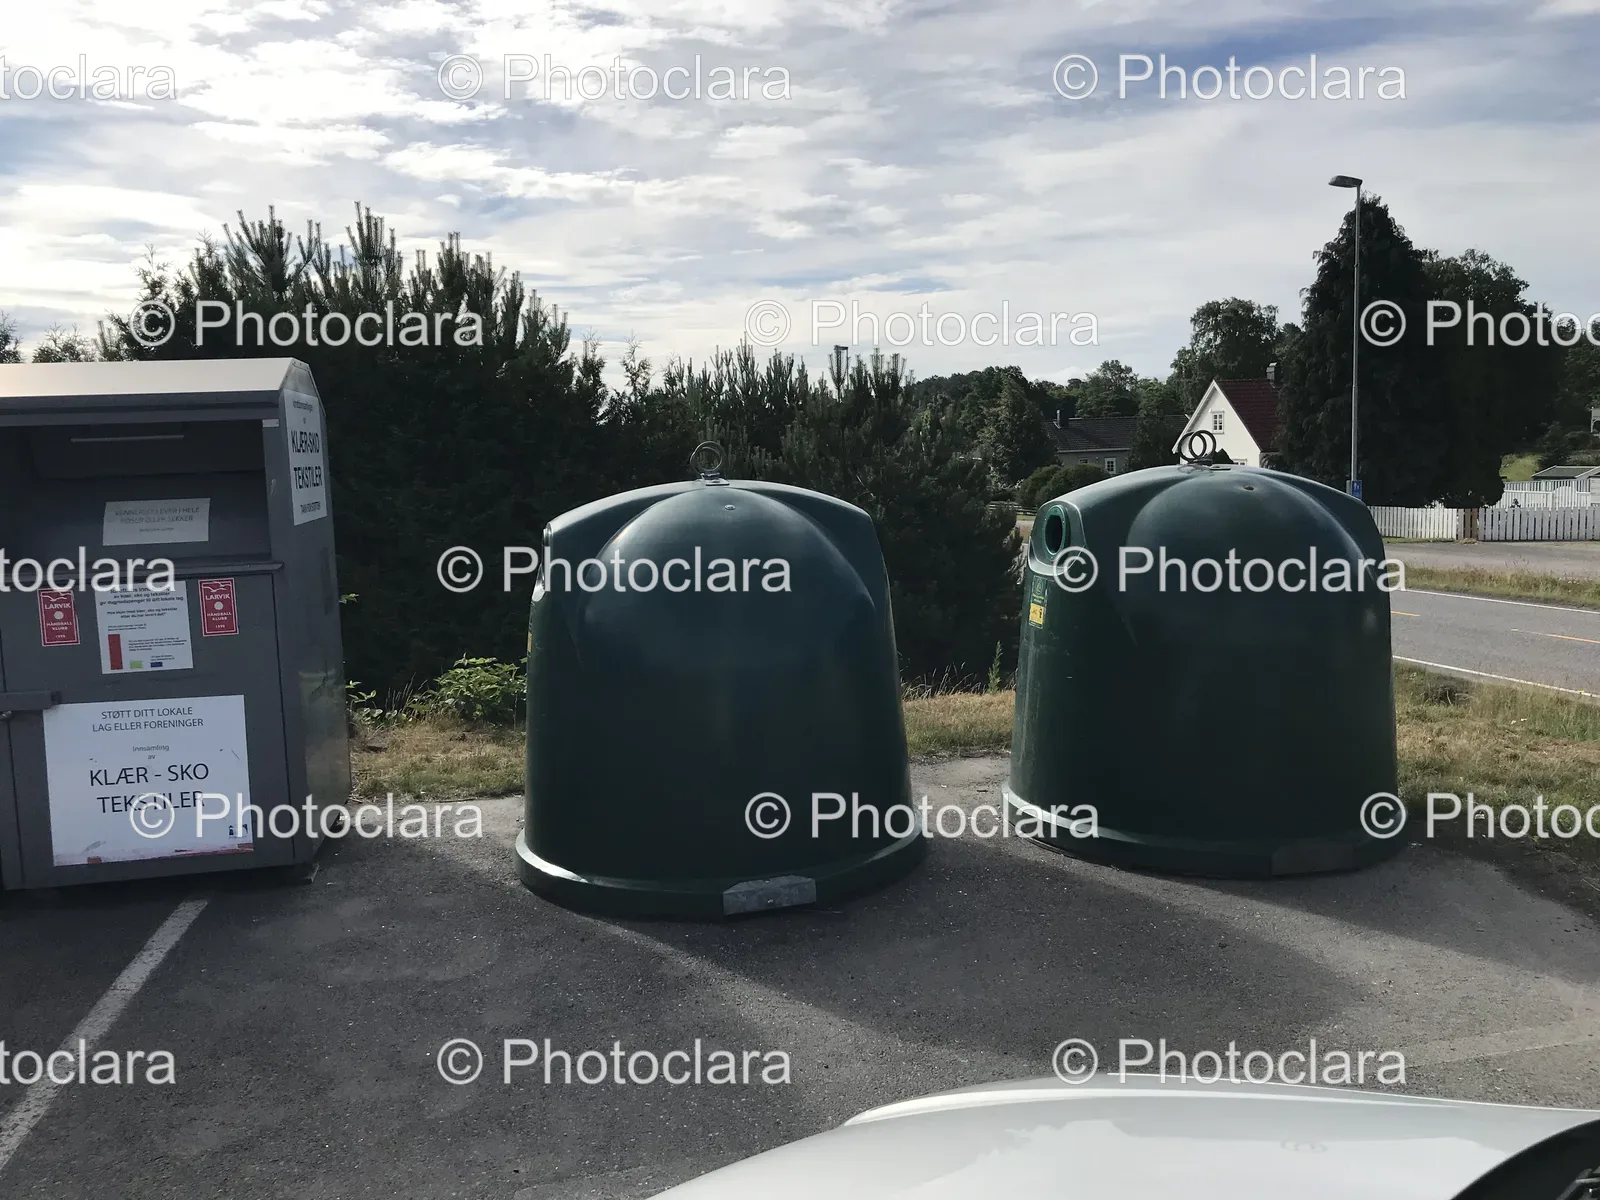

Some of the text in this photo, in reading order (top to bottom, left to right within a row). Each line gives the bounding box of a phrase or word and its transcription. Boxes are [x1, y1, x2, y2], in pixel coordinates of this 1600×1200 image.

[205, 593, 231, 601] LARVIK
[101, 706, 193, 720] STØTT DITT LOKALE
[92, 718, 204, 732] LAG ELLER FORENINGER
[90, 766, 149, 786] KLÆR
[167, 763, 209, 782] SKO
